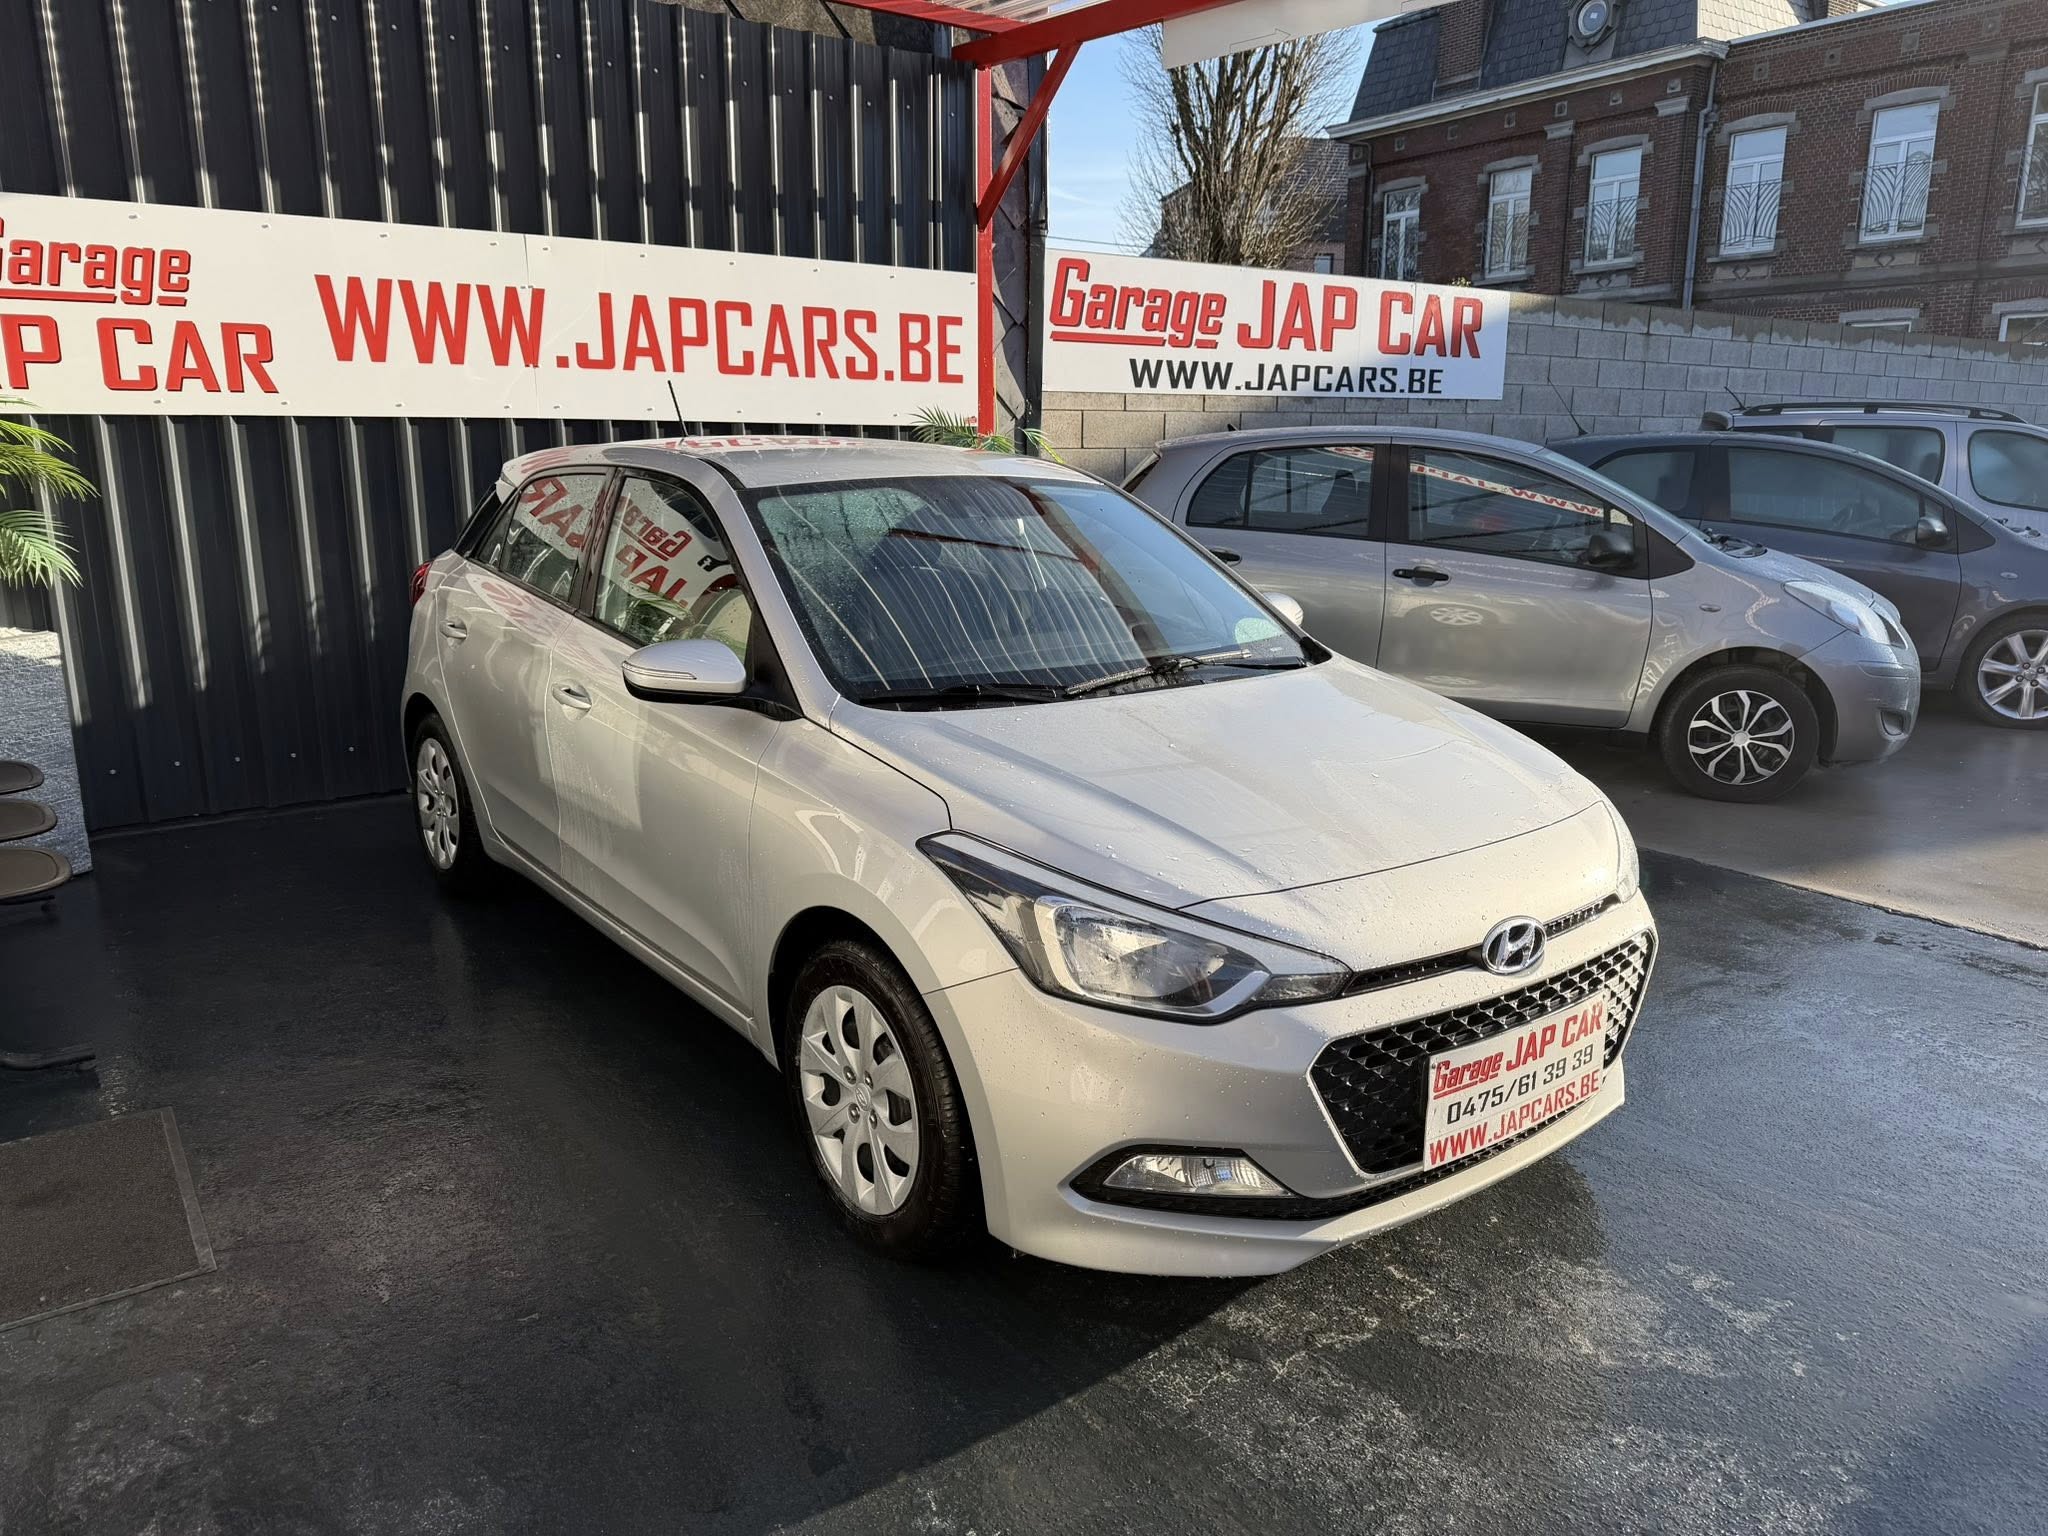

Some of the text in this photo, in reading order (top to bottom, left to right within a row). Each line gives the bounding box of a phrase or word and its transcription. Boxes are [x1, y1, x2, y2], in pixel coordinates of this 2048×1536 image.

[0, 217, 192, 305] arage
[314, 274, 965, 385] WWW.JAPCARS.BE
[1049, 257, 1484, 358] Garage JAP CAR
[0, 313, 279, 394] P CAR
[1129, 358, 1444, 394] WWW.JAPCARS.BE
[1433, 1002, 1603, 1097] Garage JAP CAR
[1447, 1044, 1594, 1125] 0475/61 39 39
[1429, 1069, 1600, 1166] WWW.JAPCARS.BE
